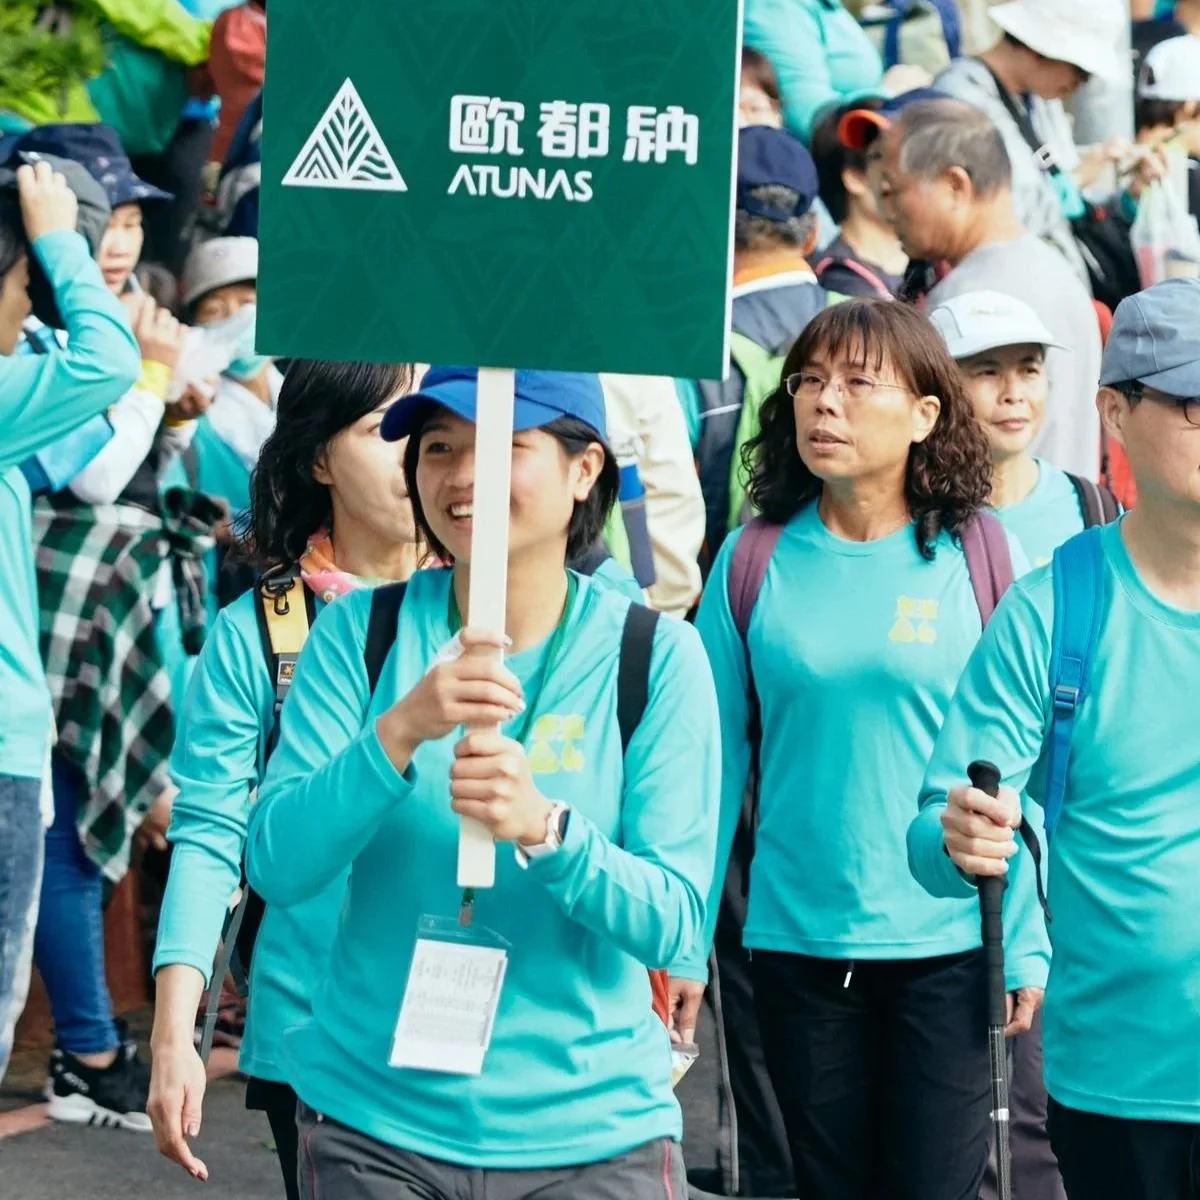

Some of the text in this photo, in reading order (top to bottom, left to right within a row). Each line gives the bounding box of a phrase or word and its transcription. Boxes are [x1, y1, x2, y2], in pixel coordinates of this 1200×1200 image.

[449, 95, 699, 164] 歐都納
[447, 164, 593, 202] ATUNAS
